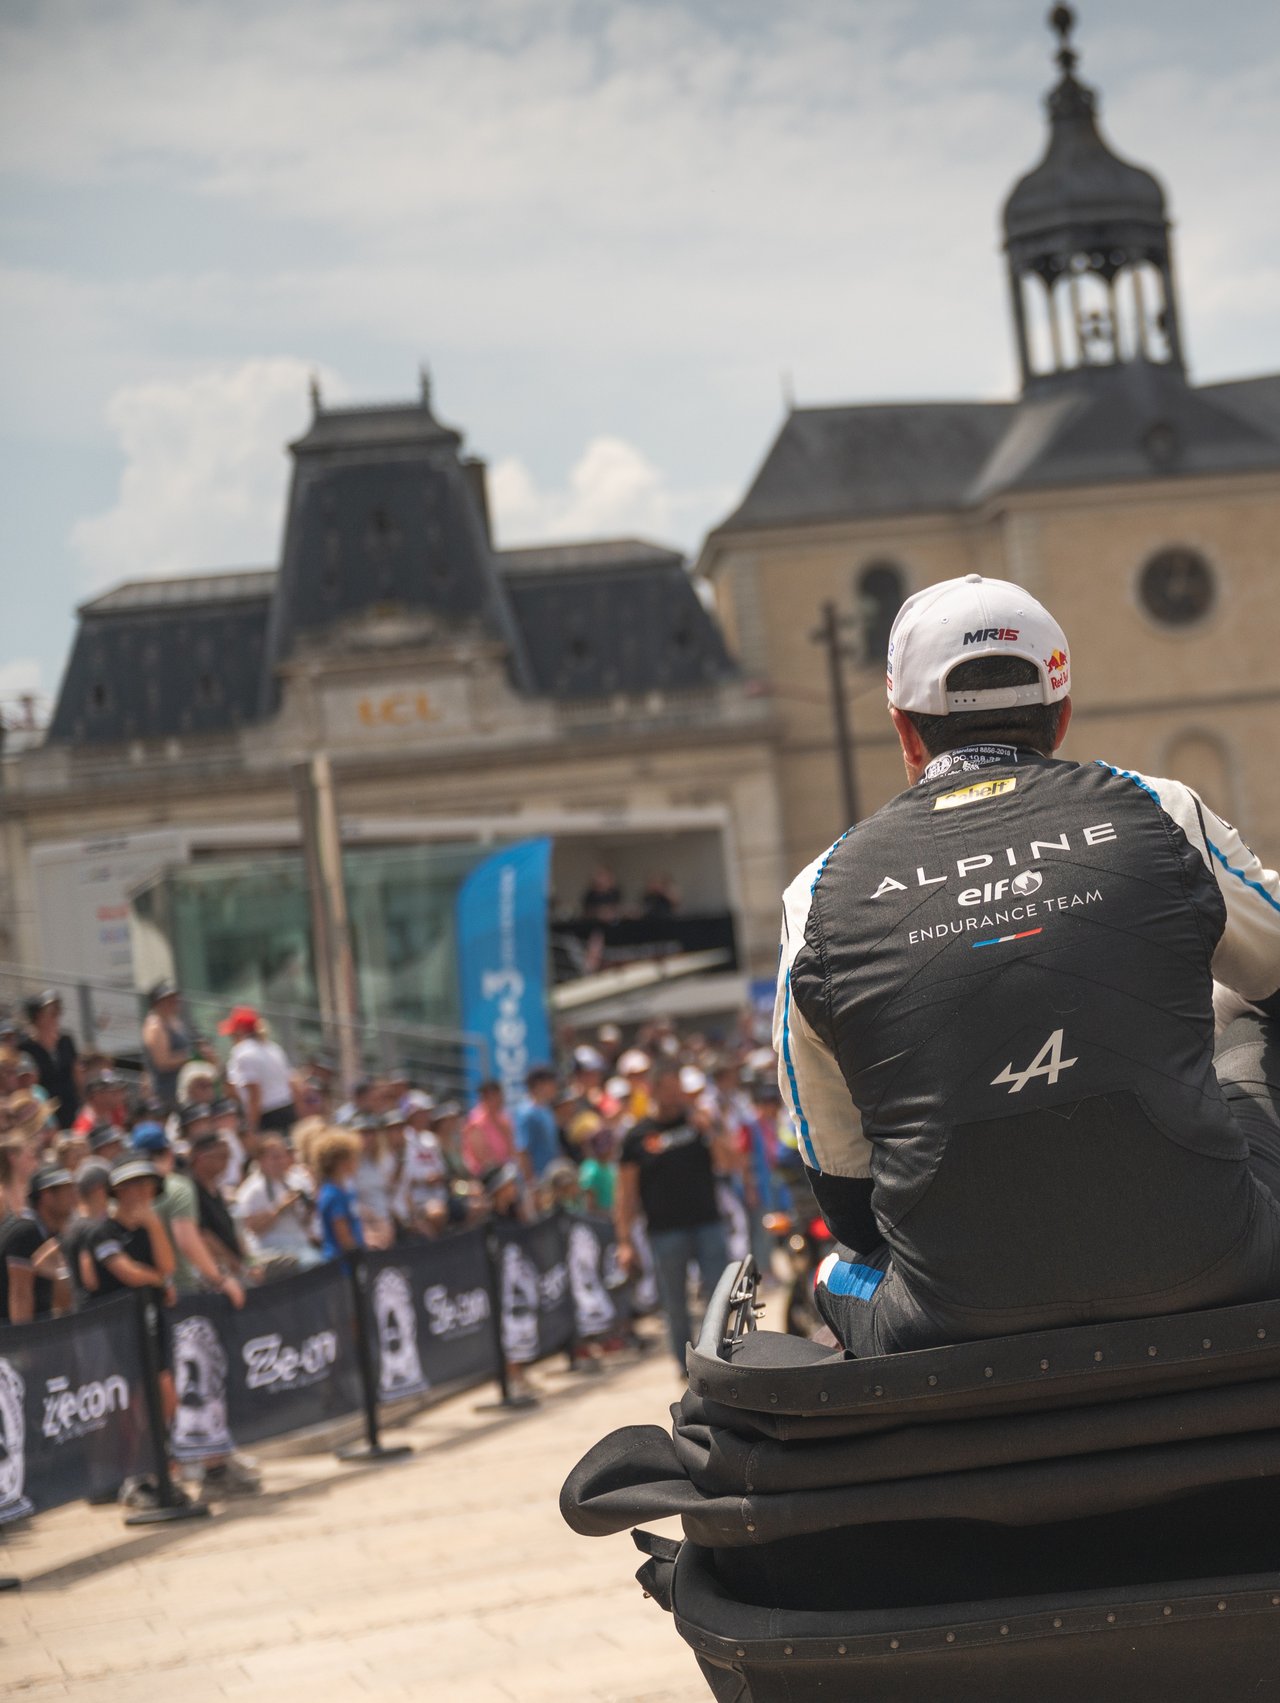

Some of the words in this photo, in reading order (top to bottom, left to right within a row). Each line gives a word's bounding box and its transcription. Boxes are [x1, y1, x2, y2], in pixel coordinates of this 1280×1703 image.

[963, 628, 1020, 646] MR15
[1050, 674, 1064, 691] Red
[869, 822, 1118, 900] ALPINE
[957, 878, 1010, 907] elf
[908, 903, 1038, 945] ENDURANCE
[1043, 889, 1103, 913] TEAM
